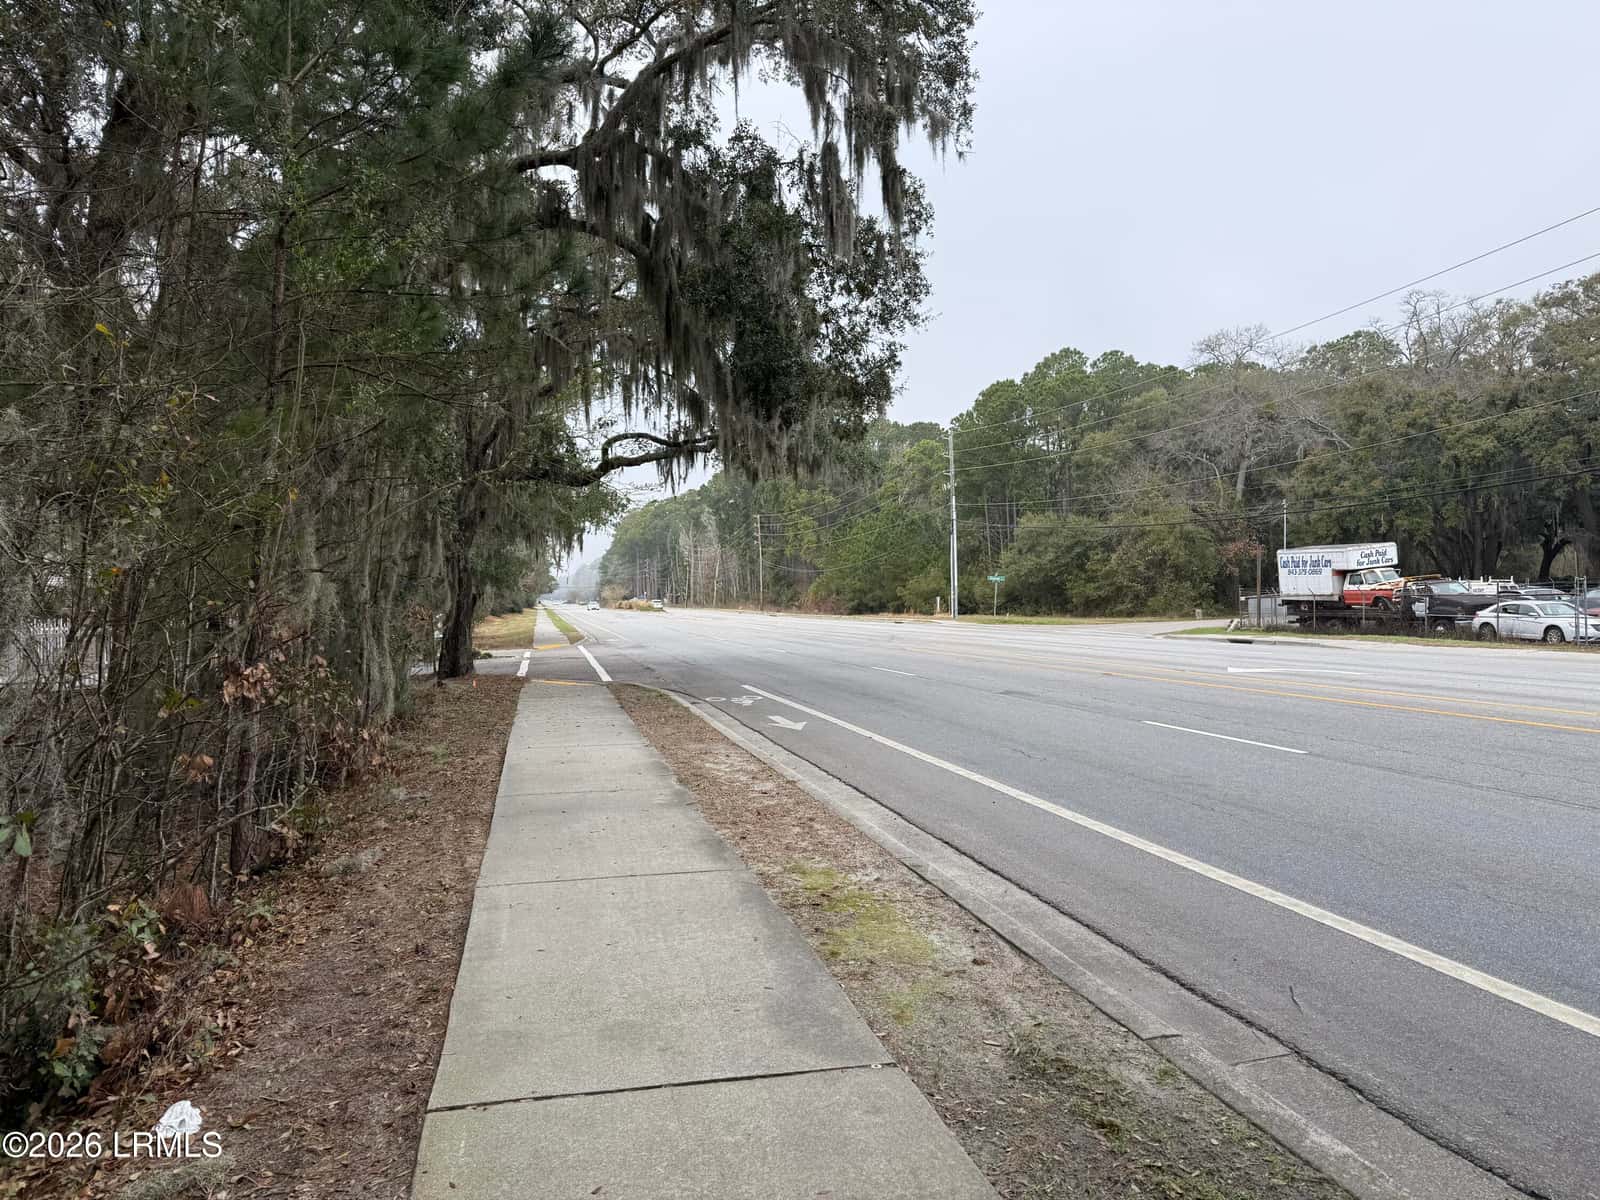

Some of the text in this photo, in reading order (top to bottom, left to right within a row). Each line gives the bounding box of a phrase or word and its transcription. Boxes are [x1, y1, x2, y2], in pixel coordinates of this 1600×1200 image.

[1360, 548, 1387, 559] Cash Paid
[1280, 556, 1290, 568] Cash
[1291, 555, 1300, 568] Paid
[1309, 555, 1321, 568] Junk
[1321, 555, 1332, 568] Cars
[1366, 557, 1380, 566] Junk
[1381, 556, 1394, 565] Cars
